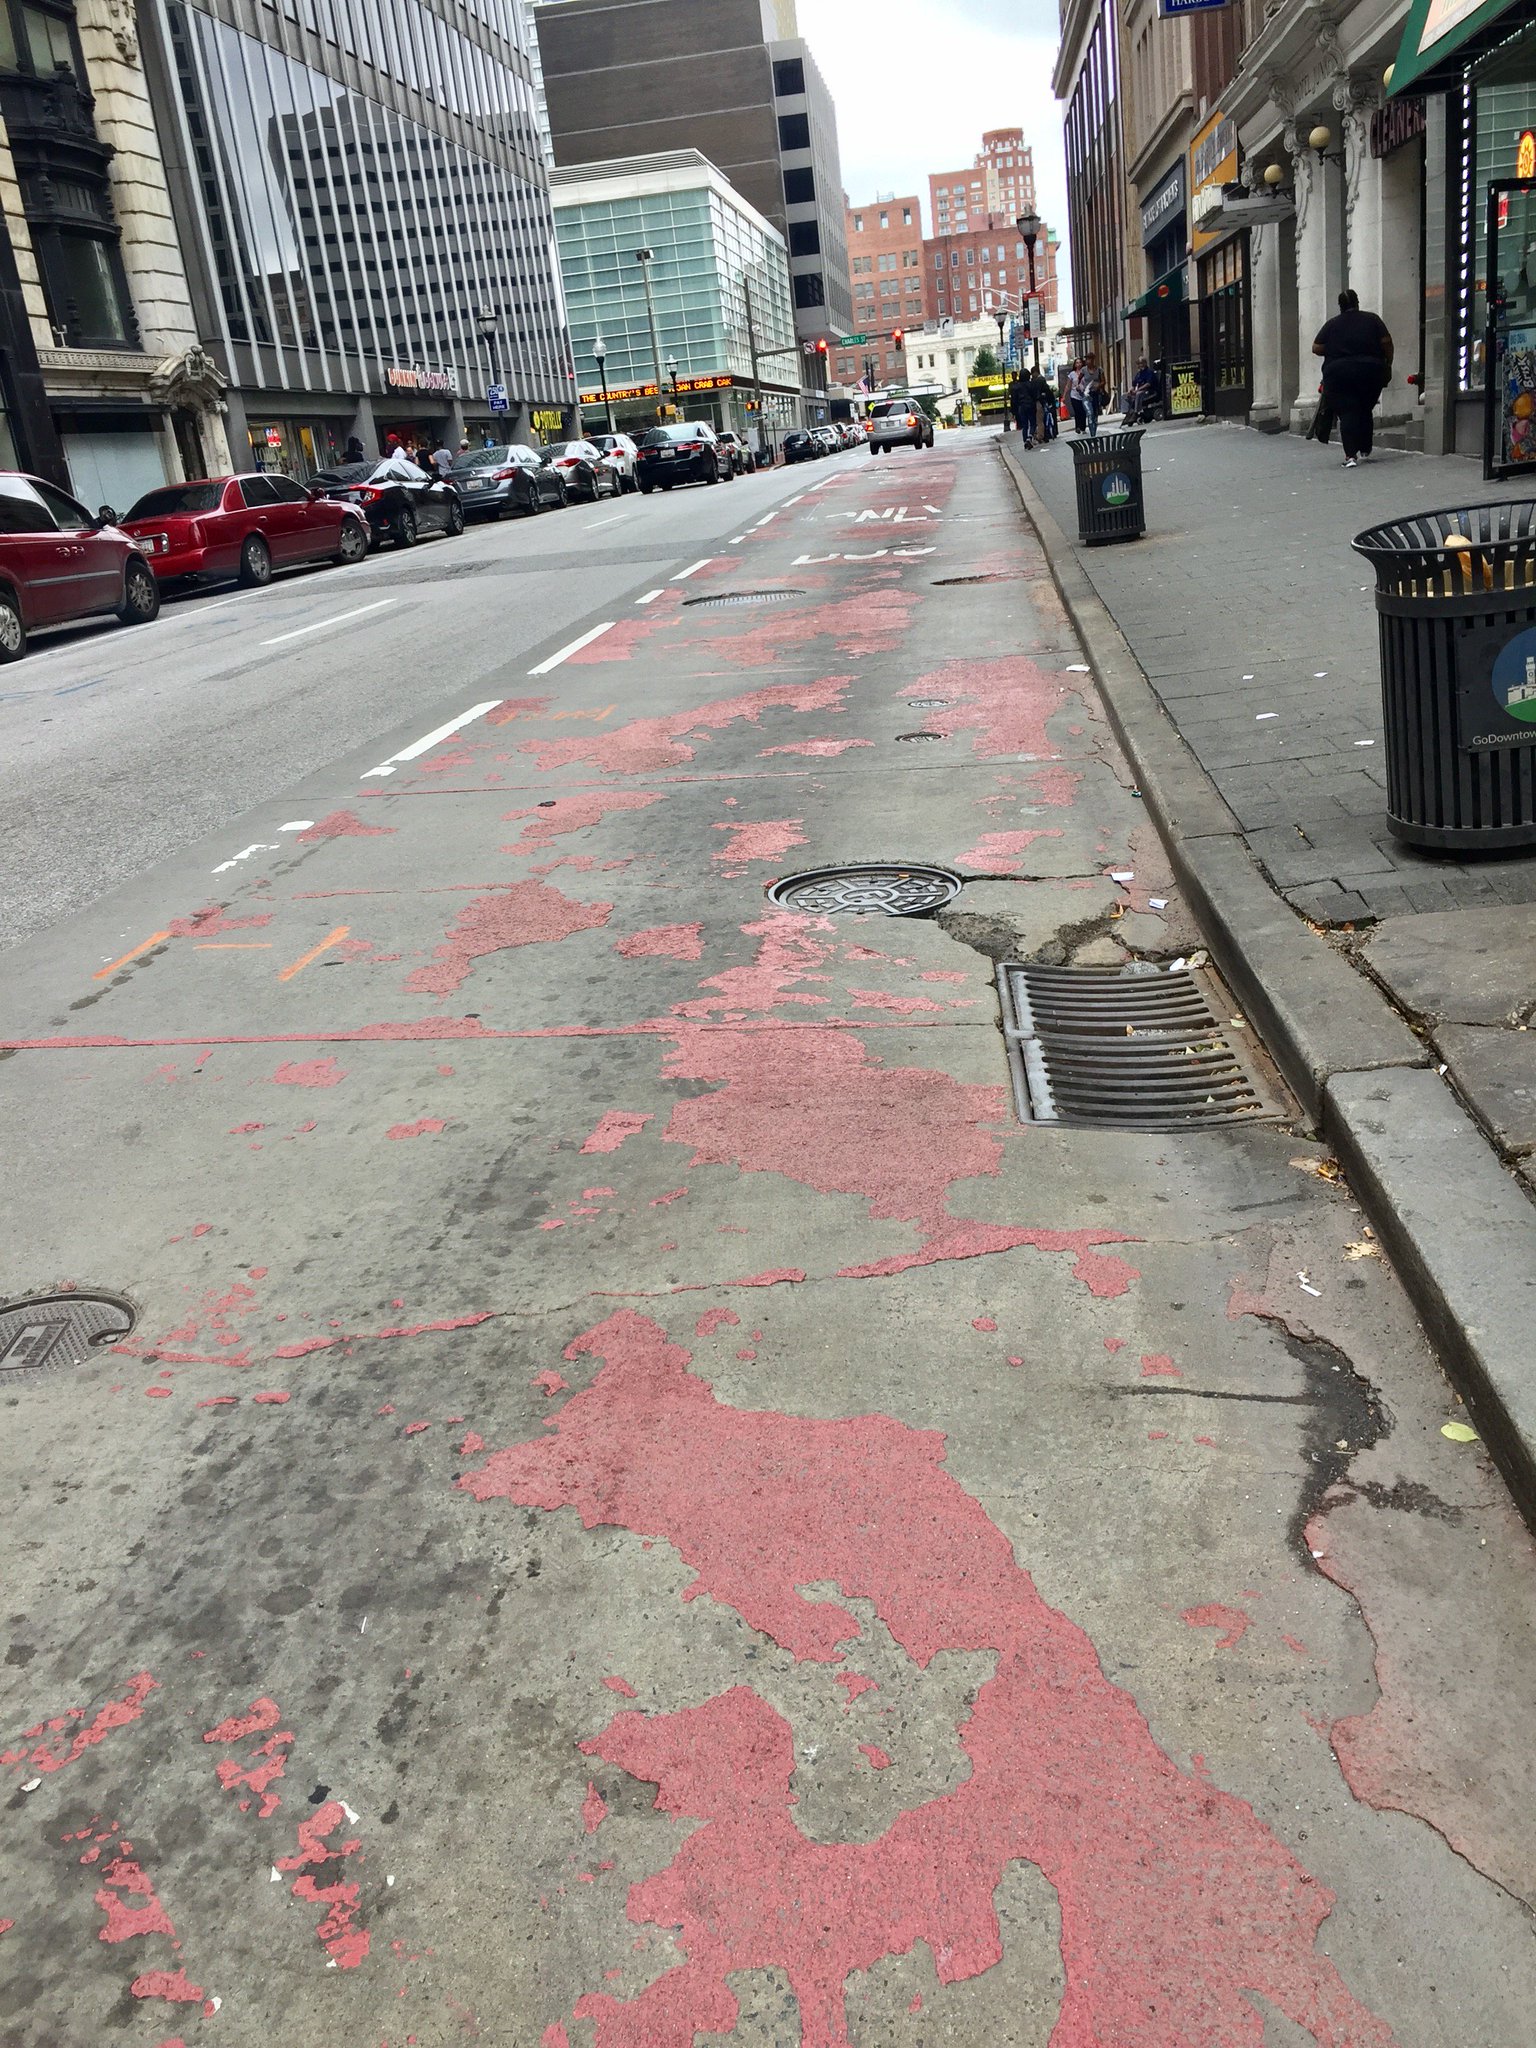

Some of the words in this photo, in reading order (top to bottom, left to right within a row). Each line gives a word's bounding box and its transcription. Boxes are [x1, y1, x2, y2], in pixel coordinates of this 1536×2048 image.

[1177, 372, 1195, 384] WE
[694, 379, 714, 390] CRAB
[582, 394, 597, 403] THE
[644, 386, 662, 396] BES
[1176, 385, 1197, 397] BUY
[1174, 397, 1200, 410] GOLD
